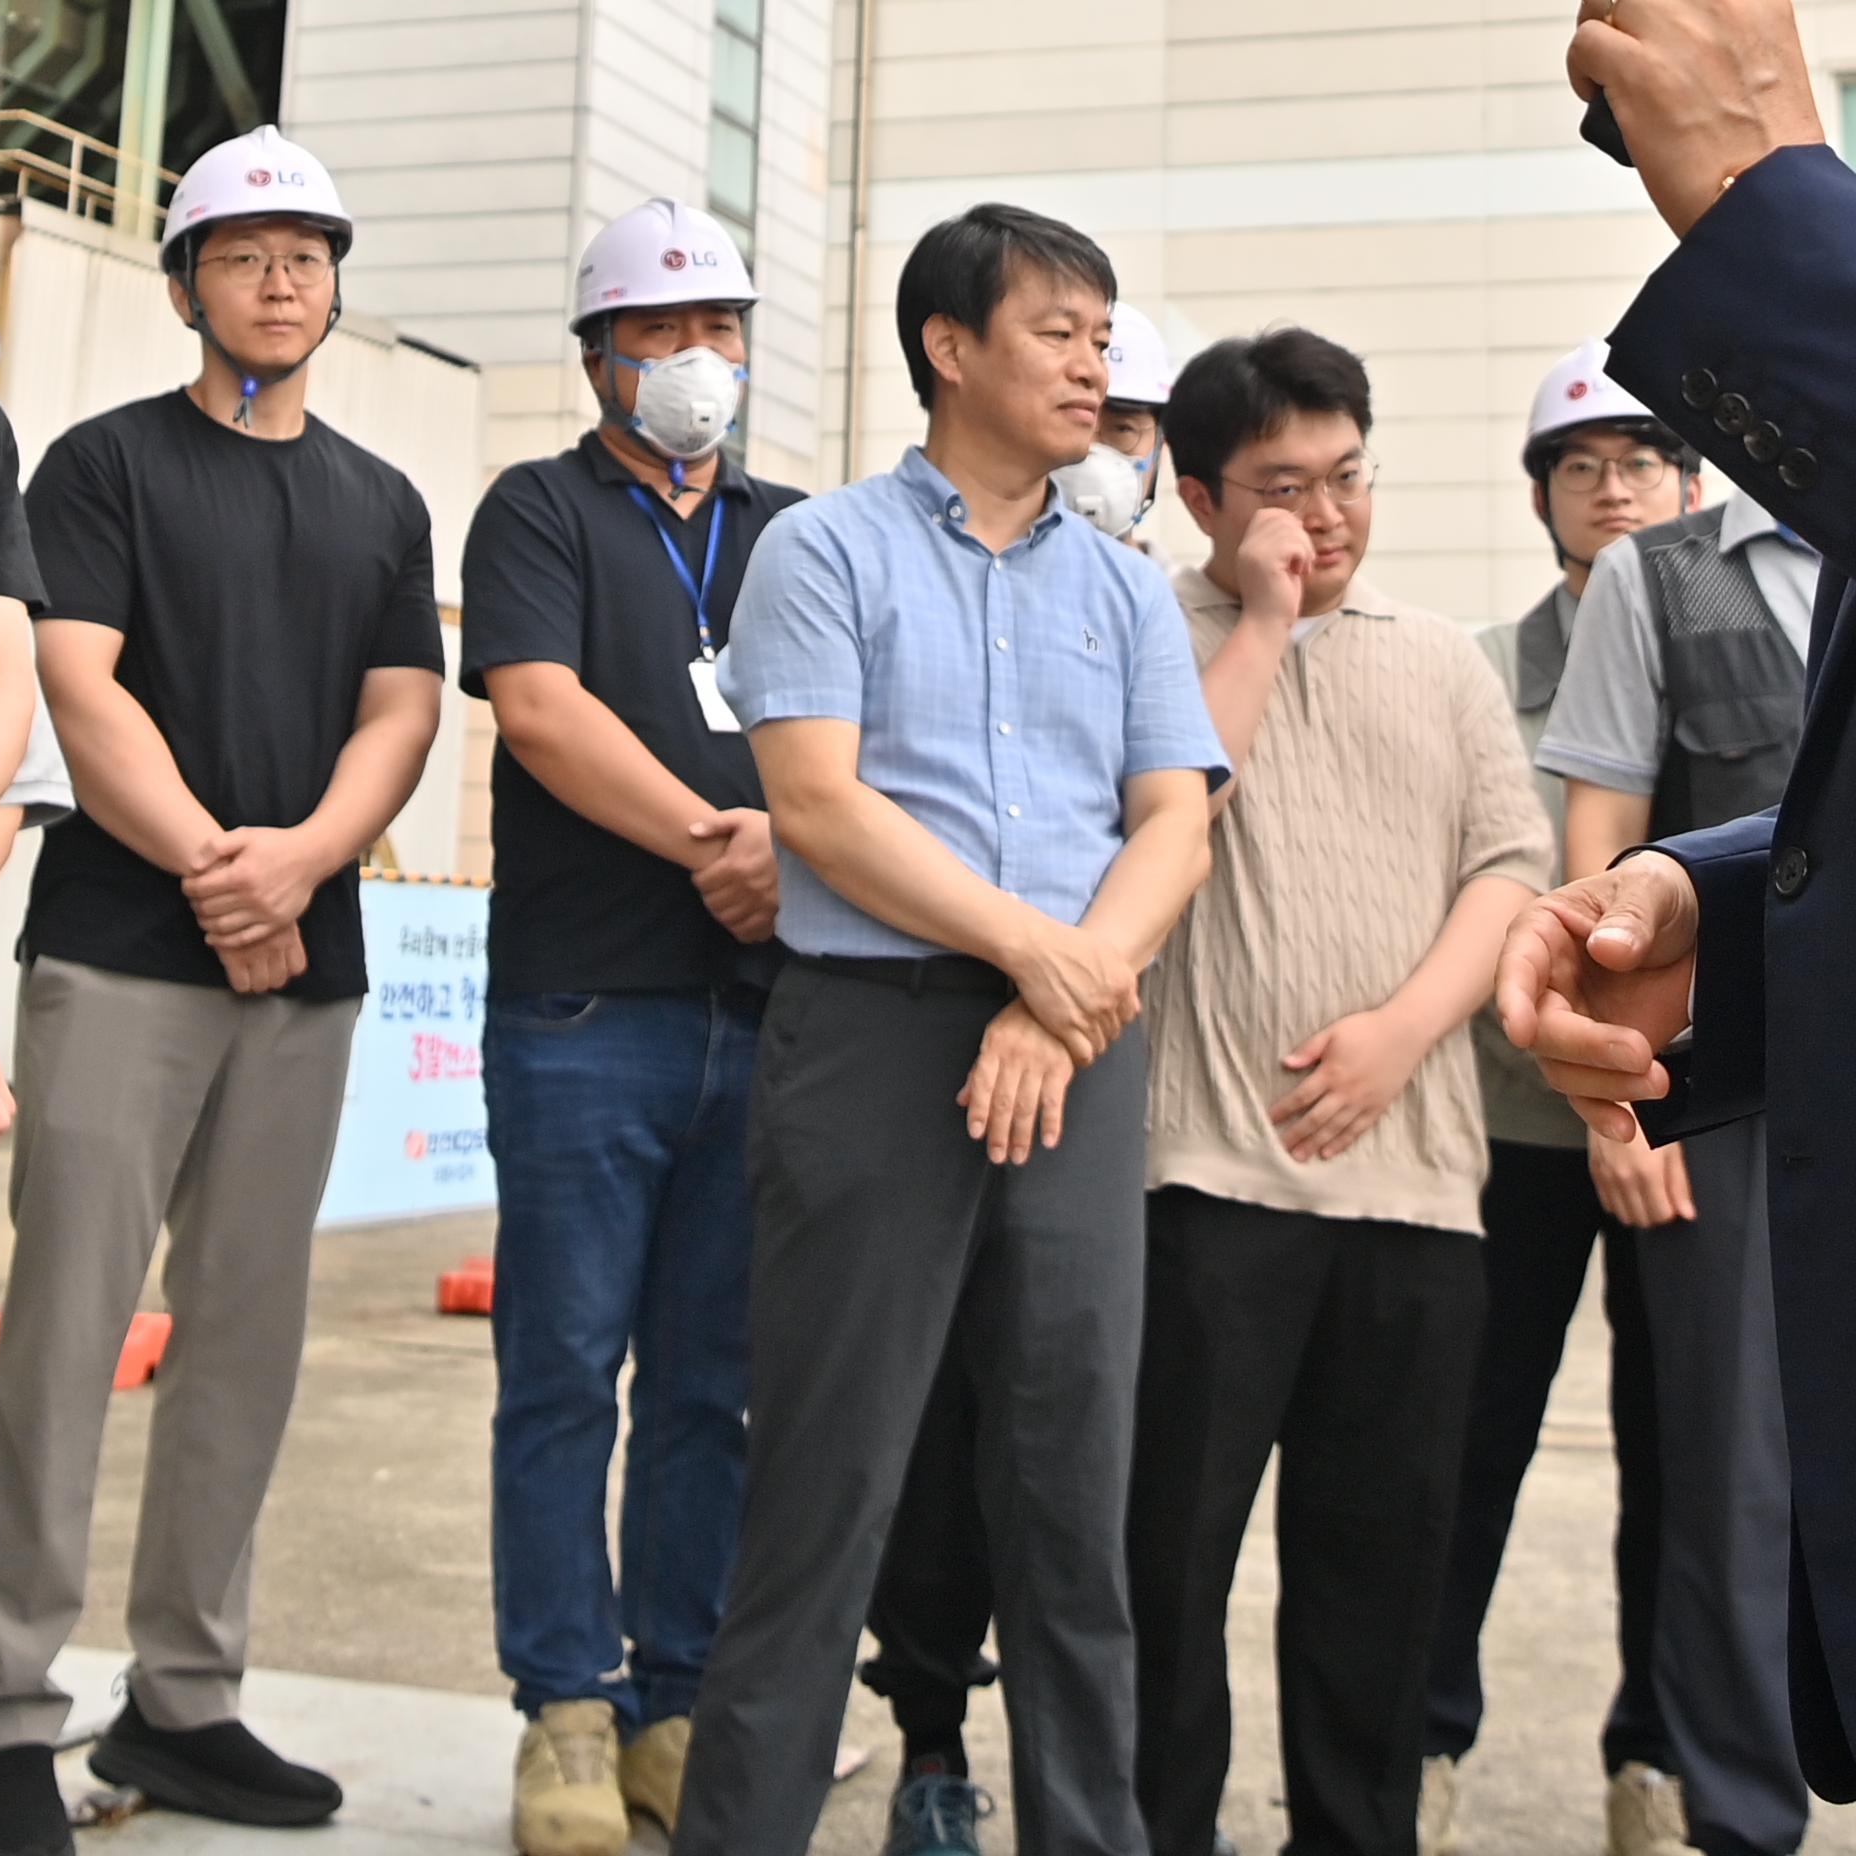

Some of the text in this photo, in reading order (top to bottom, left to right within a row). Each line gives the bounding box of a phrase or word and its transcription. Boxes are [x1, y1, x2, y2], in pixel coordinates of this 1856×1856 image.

[277, 169, 305, 187] LG
[691, 250, 718, 267] LG
[379, 975, 486, 1020] 안전하고 행
[409, 1032, 481, 1080] 3발전소
